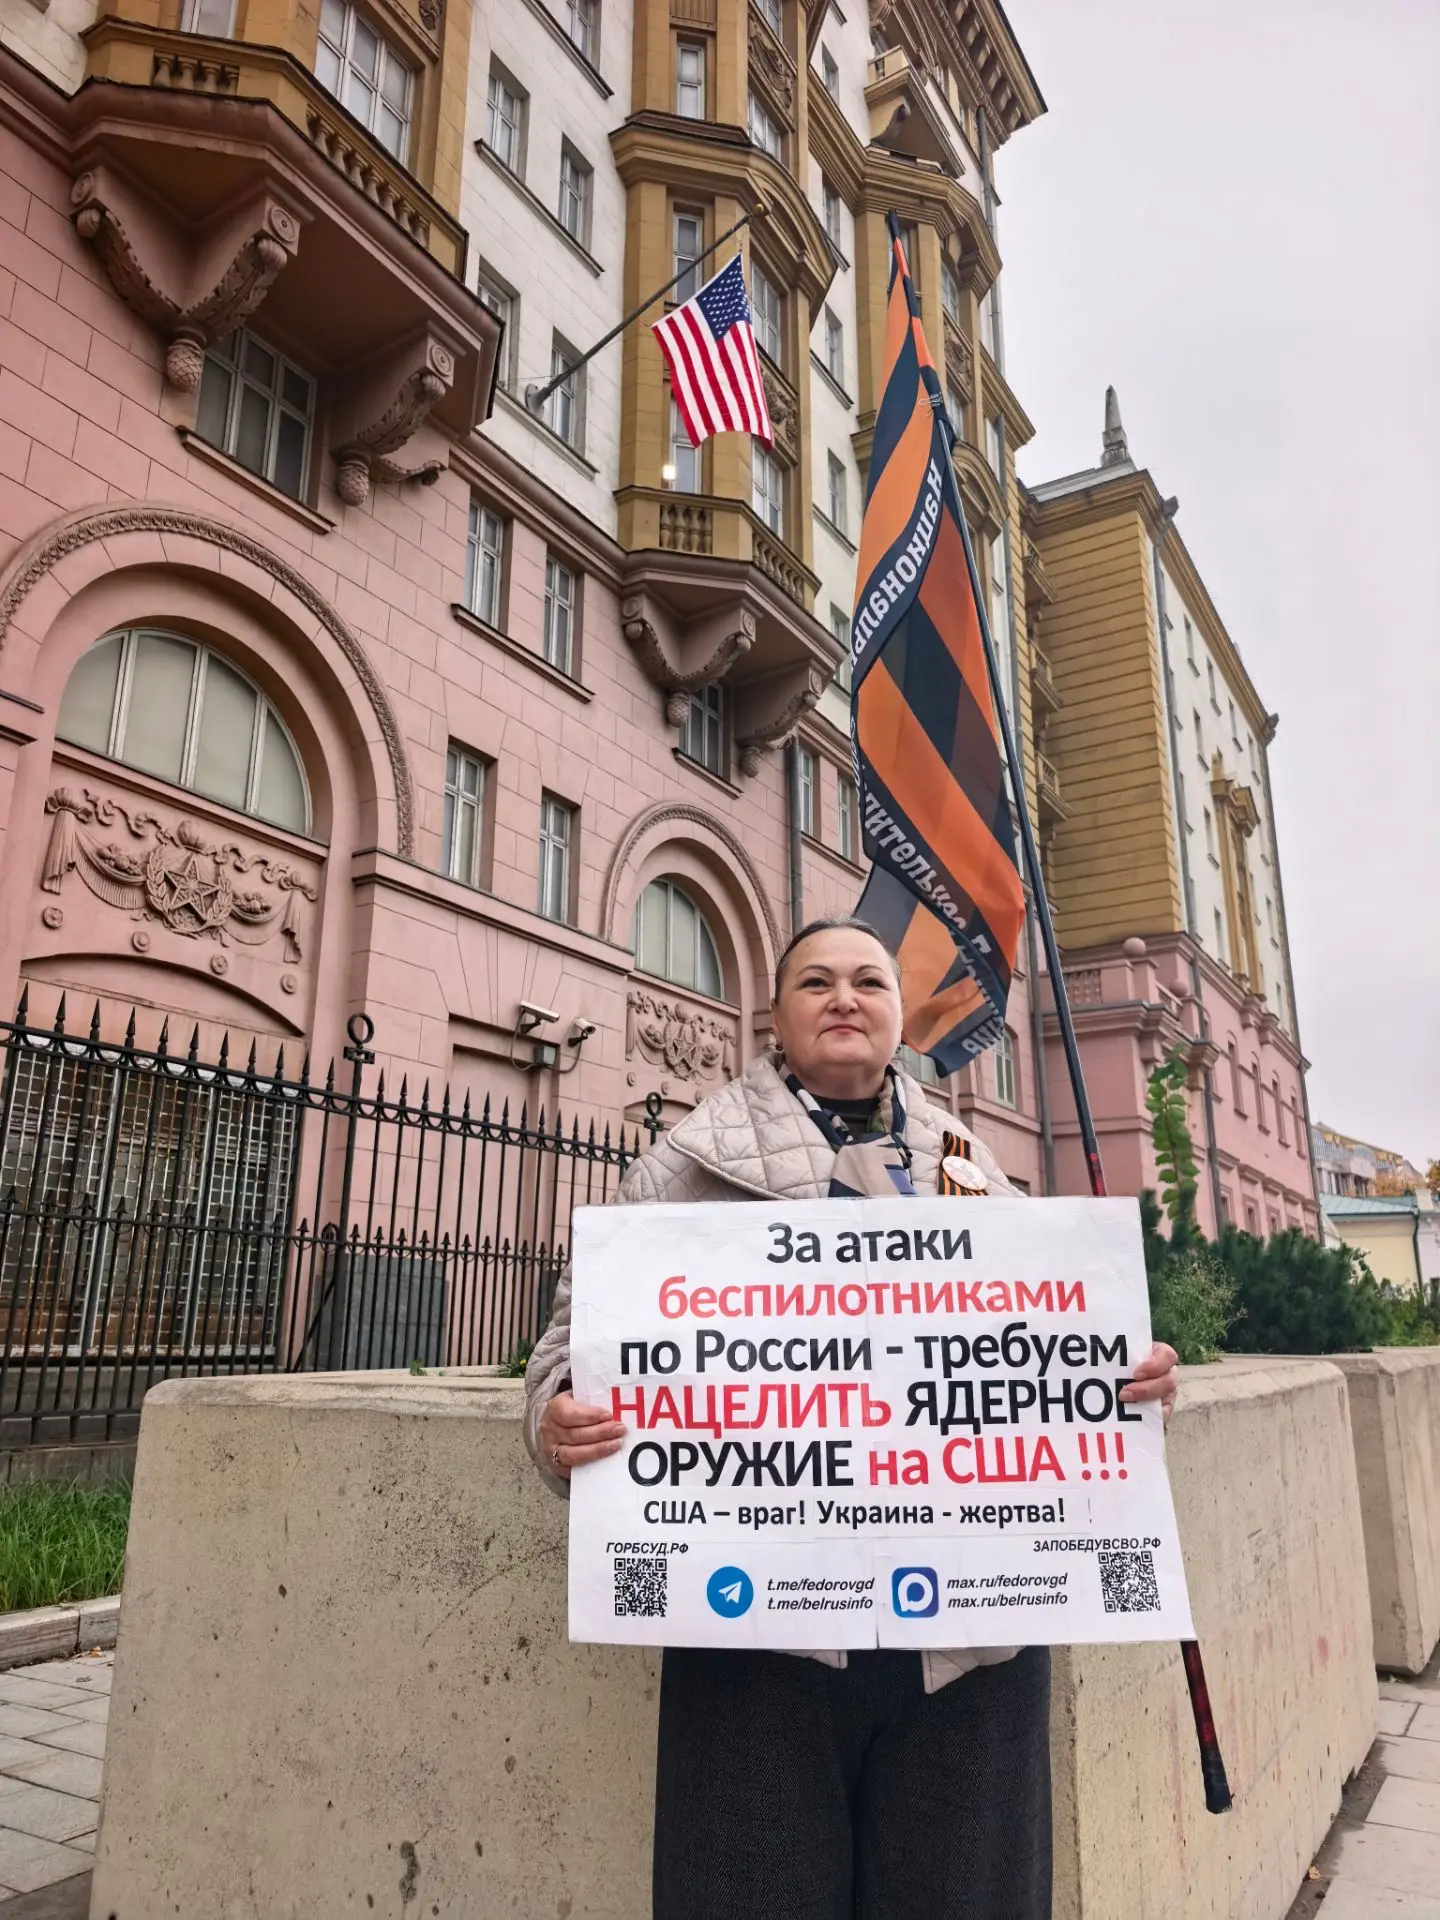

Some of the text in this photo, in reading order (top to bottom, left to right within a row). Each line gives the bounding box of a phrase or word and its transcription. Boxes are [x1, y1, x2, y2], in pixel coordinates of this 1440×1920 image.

[767, 1223, 972, 1263] За атаки
[659, 1276, 1086, 1318] беспилотниками
[621, 1341, 681, 1375] по
[696, 1330, 872, 1372] России
[914, 1322, 1128, 1378] требуем
[611, 1383, 892, 1439] НАЦЕЛИТЬ
[628, 1432, 1127, 1487] ОРУЖИЕ на США !!!
[644, 1501, 706, 1524] США
[739, 1500, 805, 1530] враг!
[817, 1501, 933, 1530] Украина
[960, 1498, 1064, 1529] жертва!
[606, 1542, 688, 1556] ГОРБСУД.РФ
[1033, 1538, 1161, 1553] ЗАПОБЕДУВСВО.РФ
[768, 1577, 875, 1593] t.me/fedorovgd
[947, 1573, 1067, 1588] max.ru/fedorovgd
[768, 1596, 873, 1610] t.me/belrusinfo
[948, 1592, 1067, 1608] max.ru/belrusinfo
